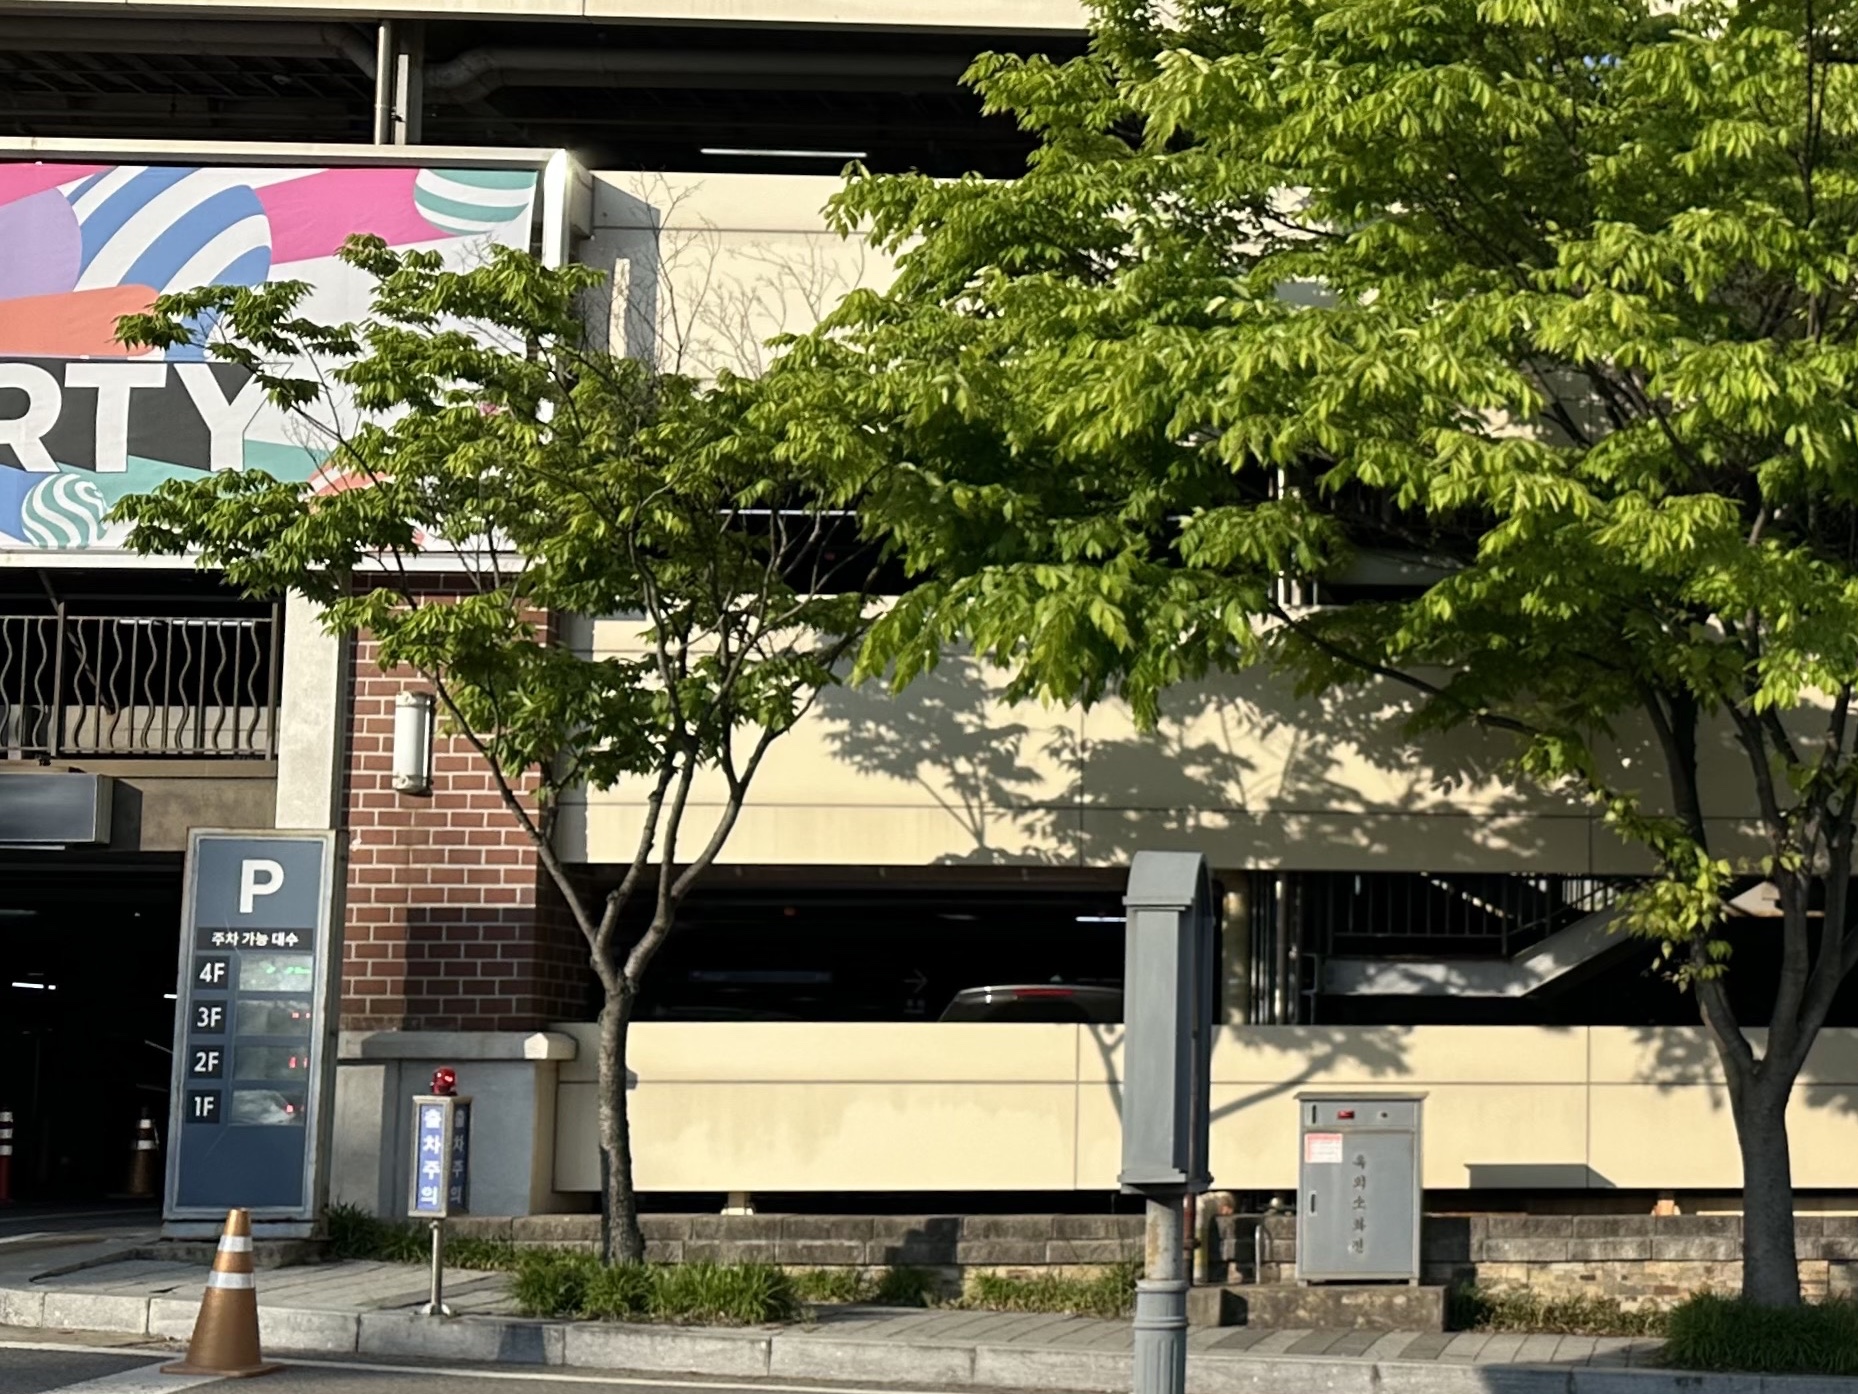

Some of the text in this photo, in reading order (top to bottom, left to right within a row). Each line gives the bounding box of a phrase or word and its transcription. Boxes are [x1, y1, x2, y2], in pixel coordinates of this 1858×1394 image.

[239, 859, 284, 914] P
[211, 931, 299, 948] 주차 가능 대수
[199, 962, 225, 983] 4F
[197, 1007, 222, 1028] 3F
[194, 1051, 219, 1072] 2F
[194, 1096, 215, 1117] 1F
